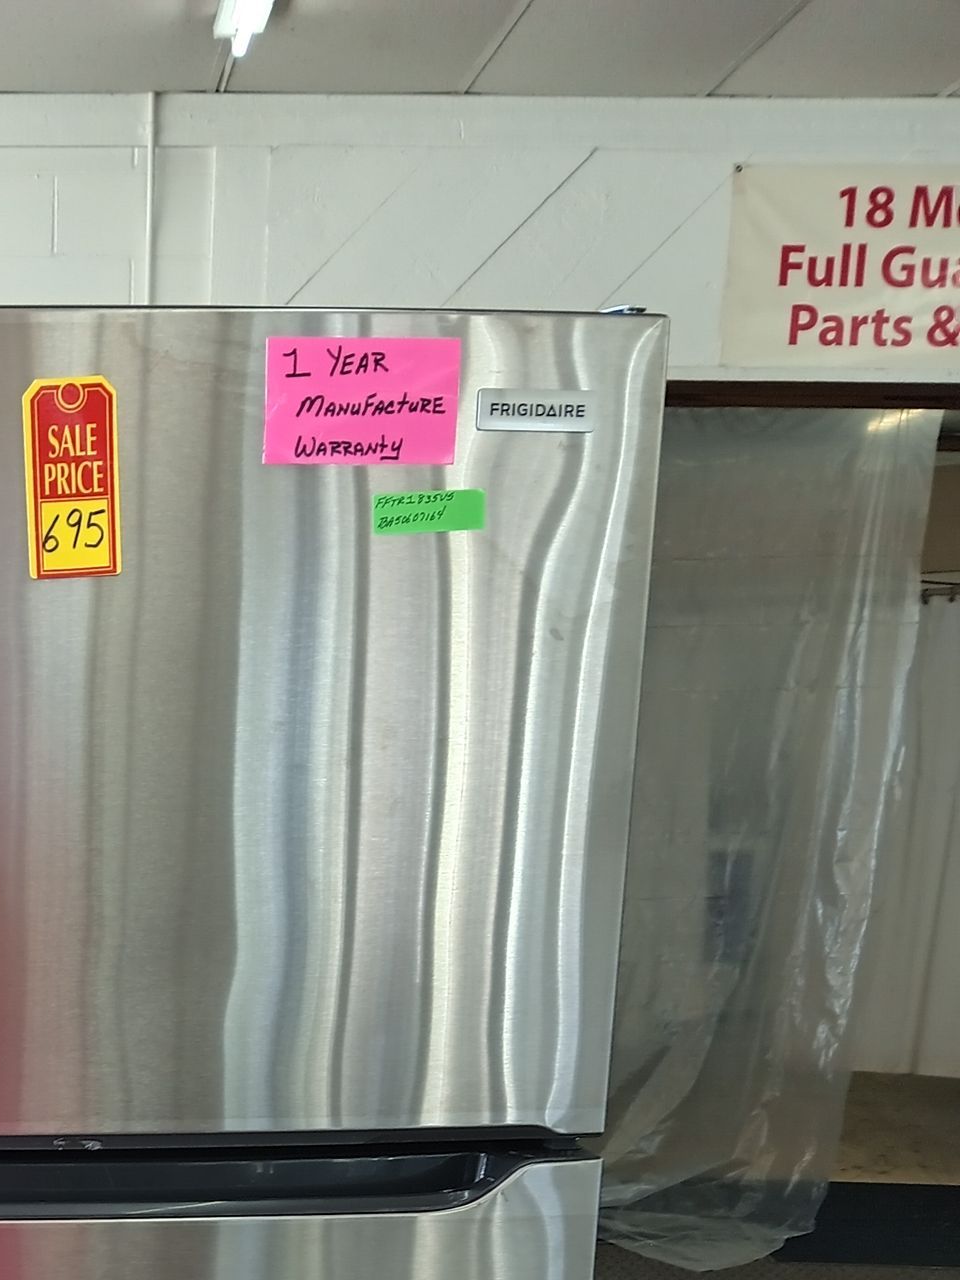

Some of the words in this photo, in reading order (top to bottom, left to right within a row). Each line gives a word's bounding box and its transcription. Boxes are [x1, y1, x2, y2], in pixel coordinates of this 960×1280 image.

[839, 185, 895, 228] 18
[908, 185, 960, 229] M
[778, 243, 868, 287] Full
[788, 303, 913, 347] Parts
[926, 304, 960, 347] &
[283, 348, 311, 378] 1
[326, 345, 390, 378] YEAR
[489, 402, 586, 418] FRIGIDAIRE
[47, 423, 97, 458] SALE
[44, 461, 105, 495] PRICE
[42, 508, 107, 554] 695
